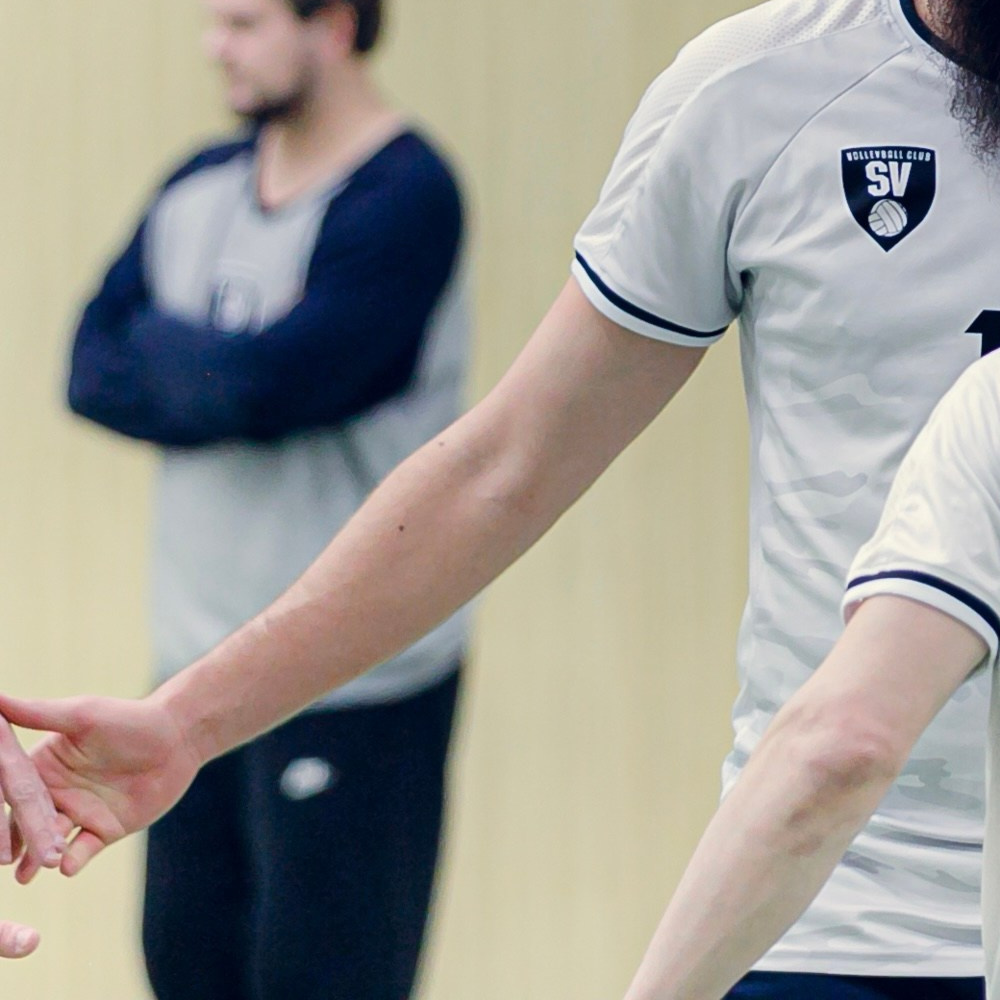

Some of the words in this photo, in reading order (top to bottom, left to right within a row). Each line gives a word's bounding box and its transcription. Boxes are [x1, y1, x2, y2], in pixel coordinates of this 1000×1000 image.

[846, 149, 903, 161] VOLLEYBALL
[906, 150, 932, 161] CLUB
[865, 160, 912, 197] SV
